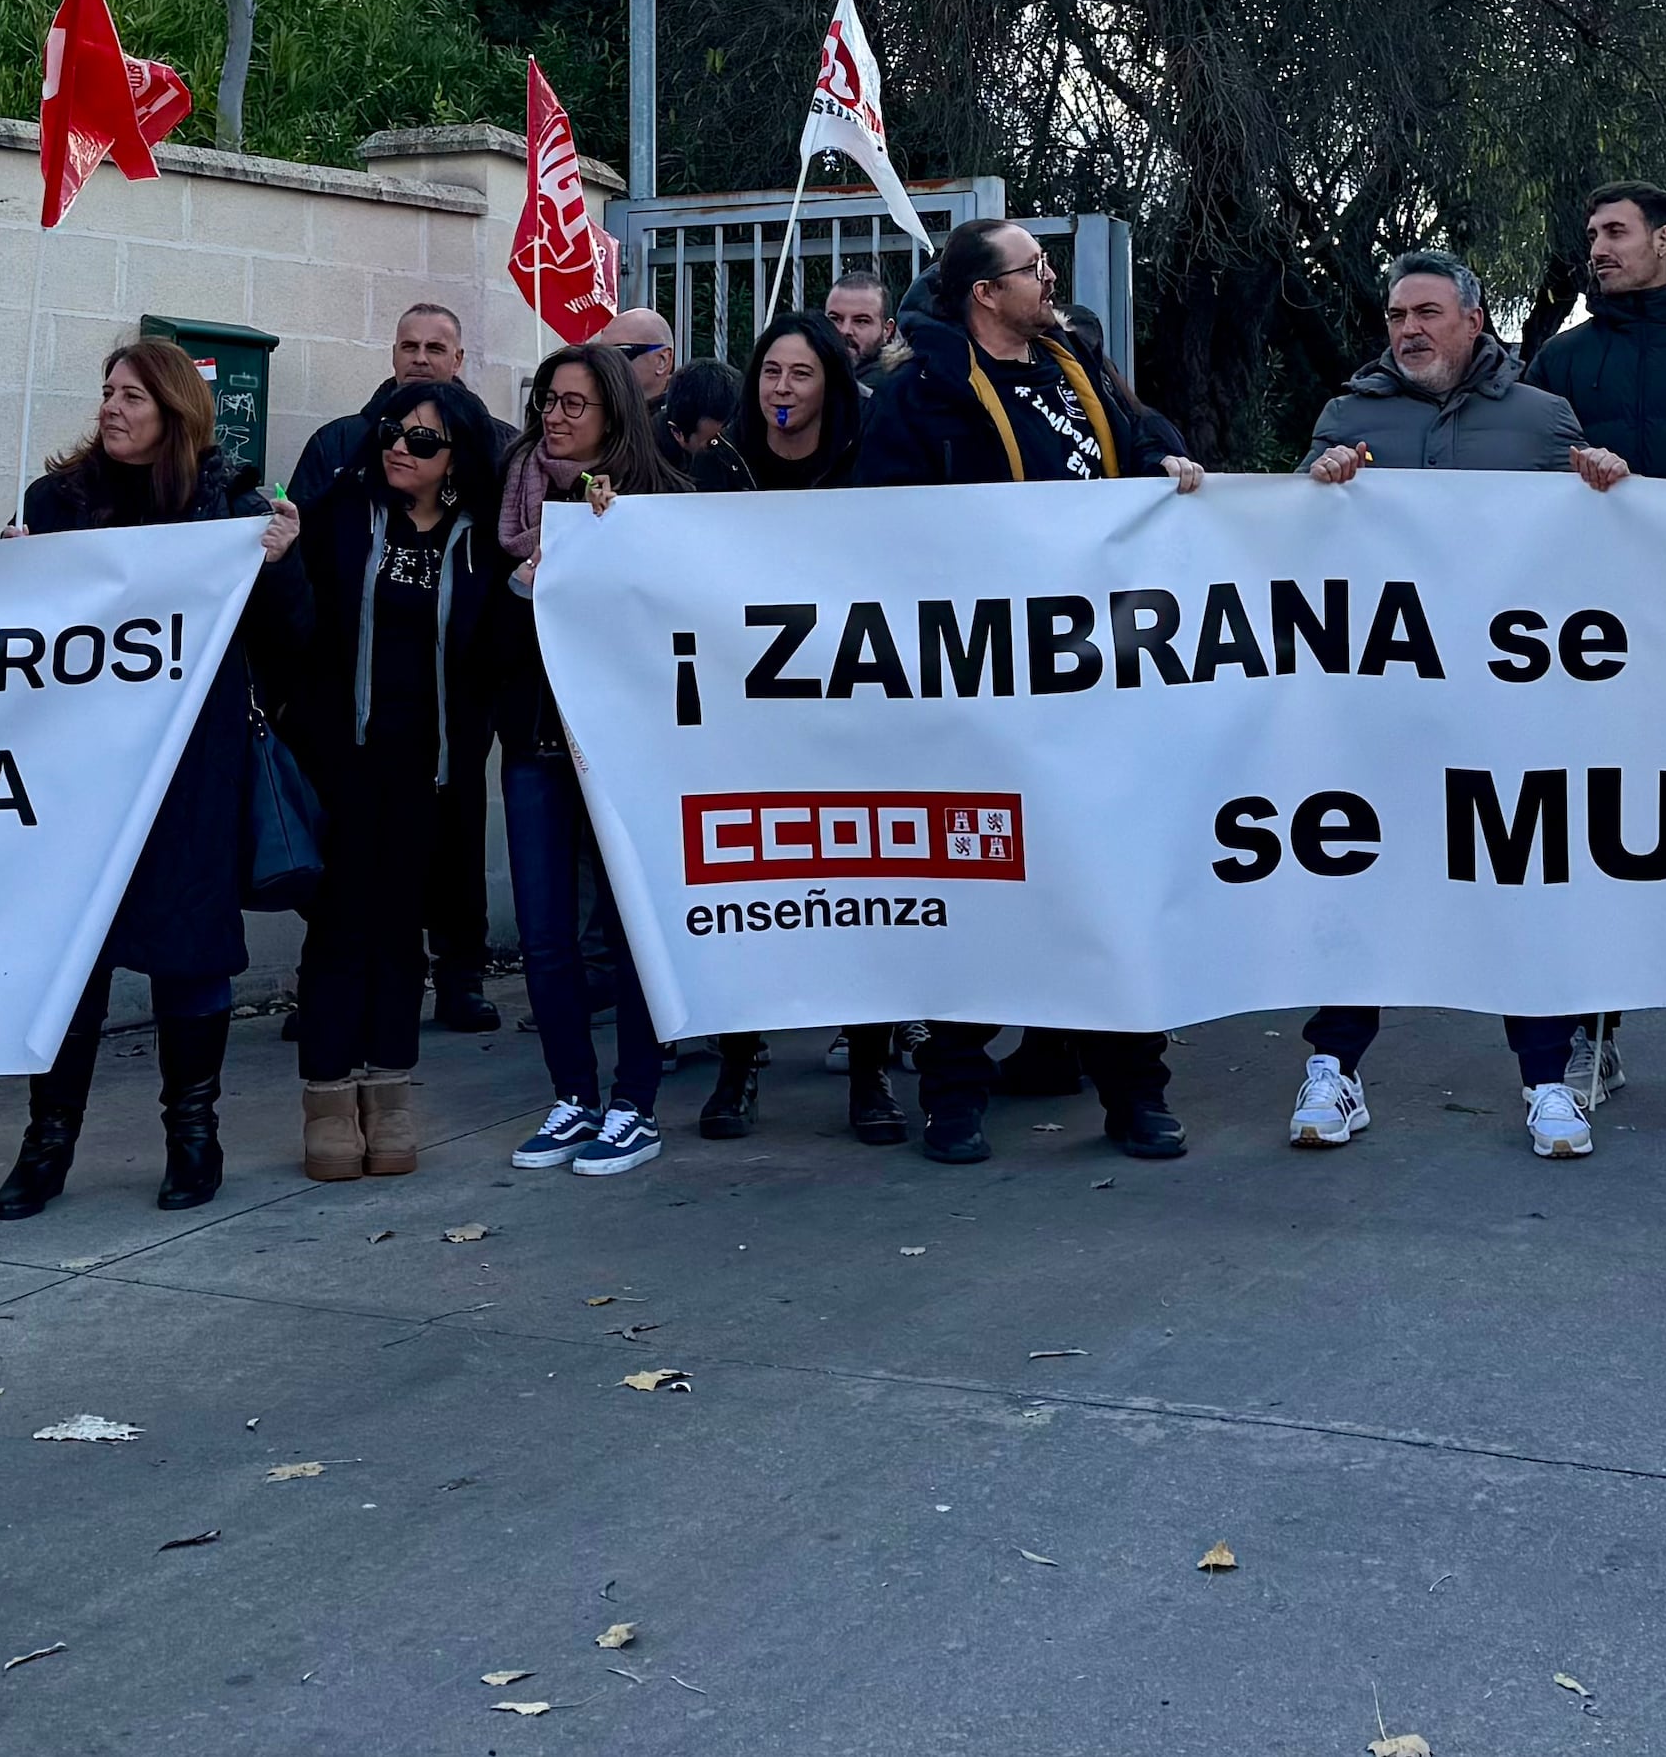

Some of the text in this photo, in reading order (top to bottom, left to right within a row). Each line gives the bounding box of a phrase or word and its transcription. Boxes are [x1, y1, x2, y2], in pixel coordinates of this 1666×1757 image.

[743, 578, 1447, 700] ZAMBRANA
[1486, 608, 1630, 684] se
[700, 805, 932, 865] CCOO
[1210, 789, 1383, 885] se
[685, 888, 949, 938] enseñanza
